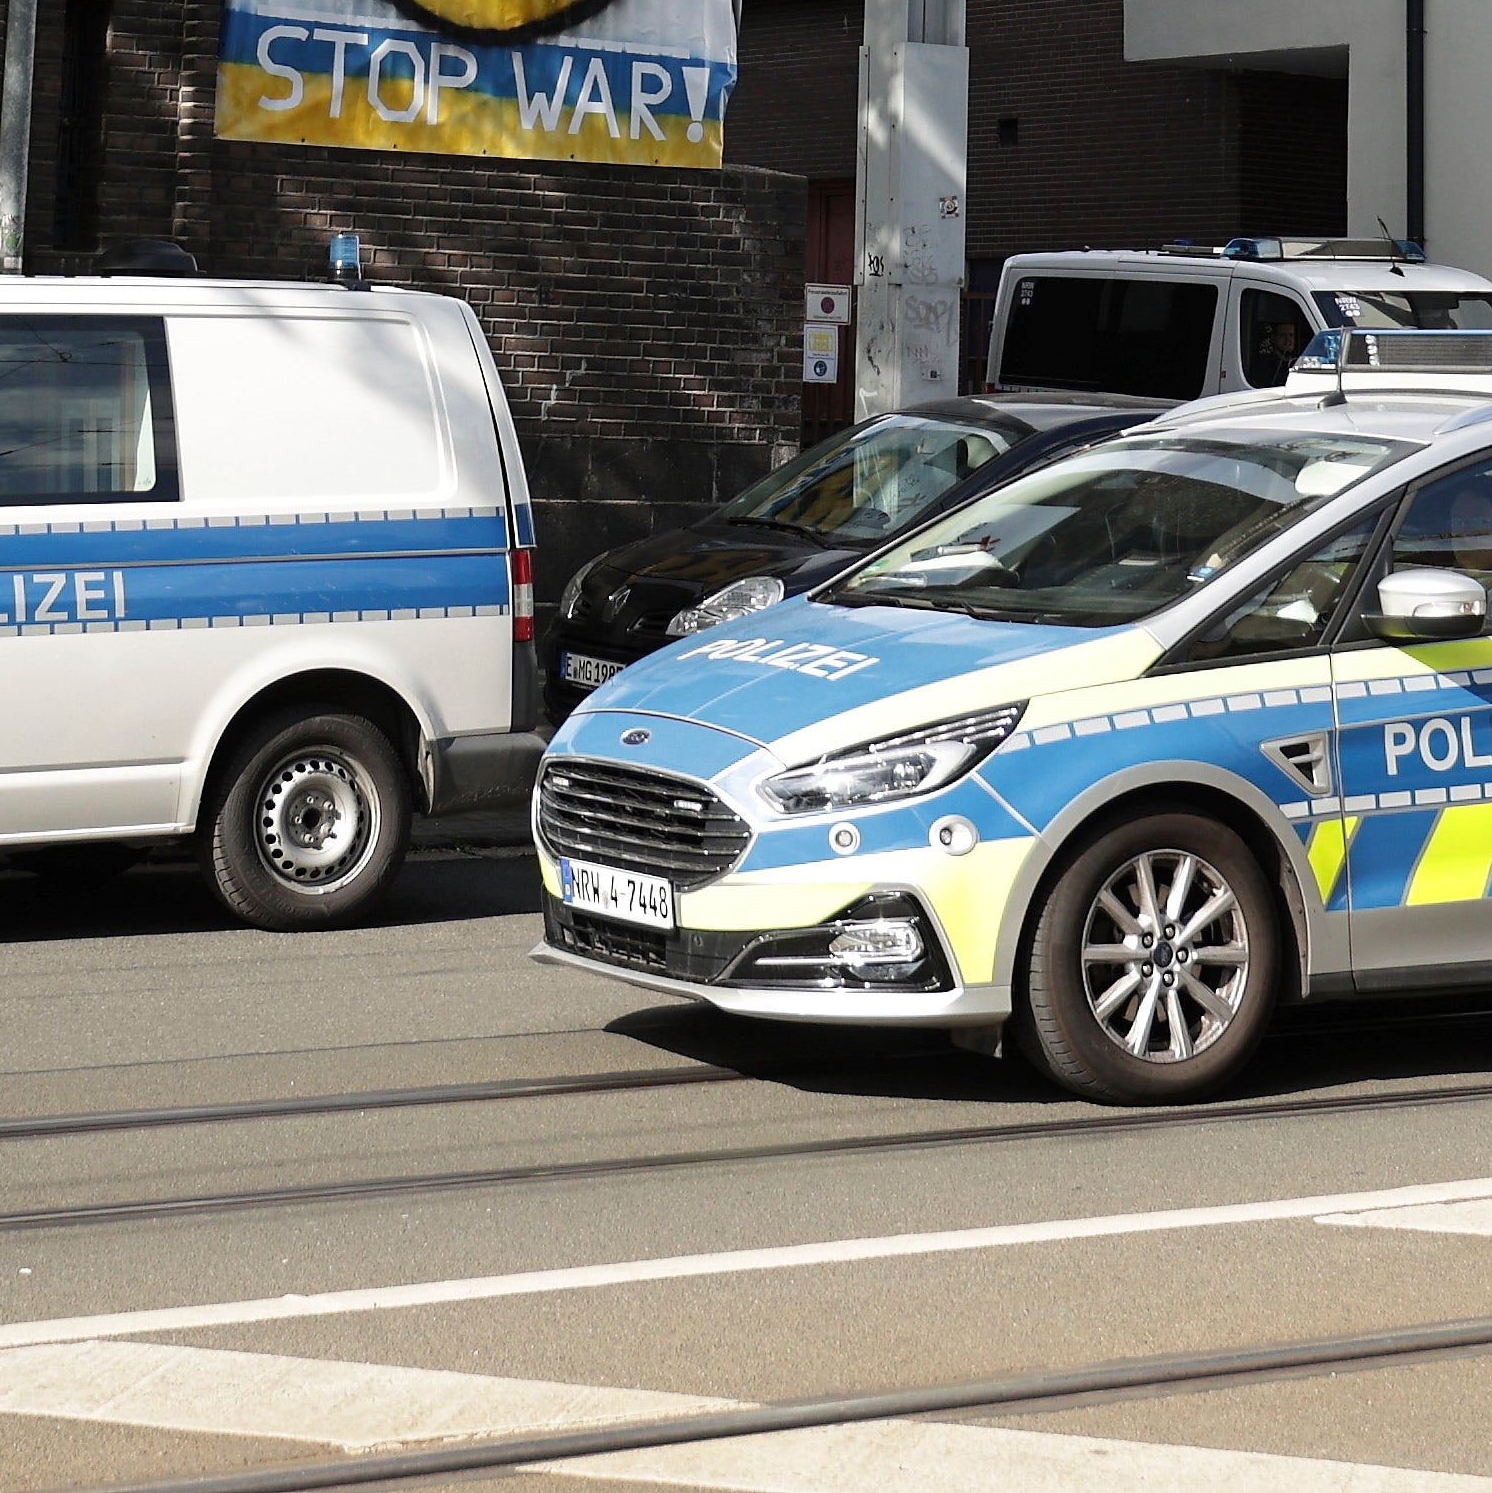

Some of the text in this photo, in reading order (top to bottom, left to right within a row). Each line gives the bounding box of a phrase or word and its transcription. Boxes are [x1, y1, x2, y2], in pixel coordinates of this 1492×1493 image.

[256, 25, 710, 144] STOP WAR!
[676, 637, 881, 681] POLIZEI
[571, 866, 668, 919] NRW 4-7448
